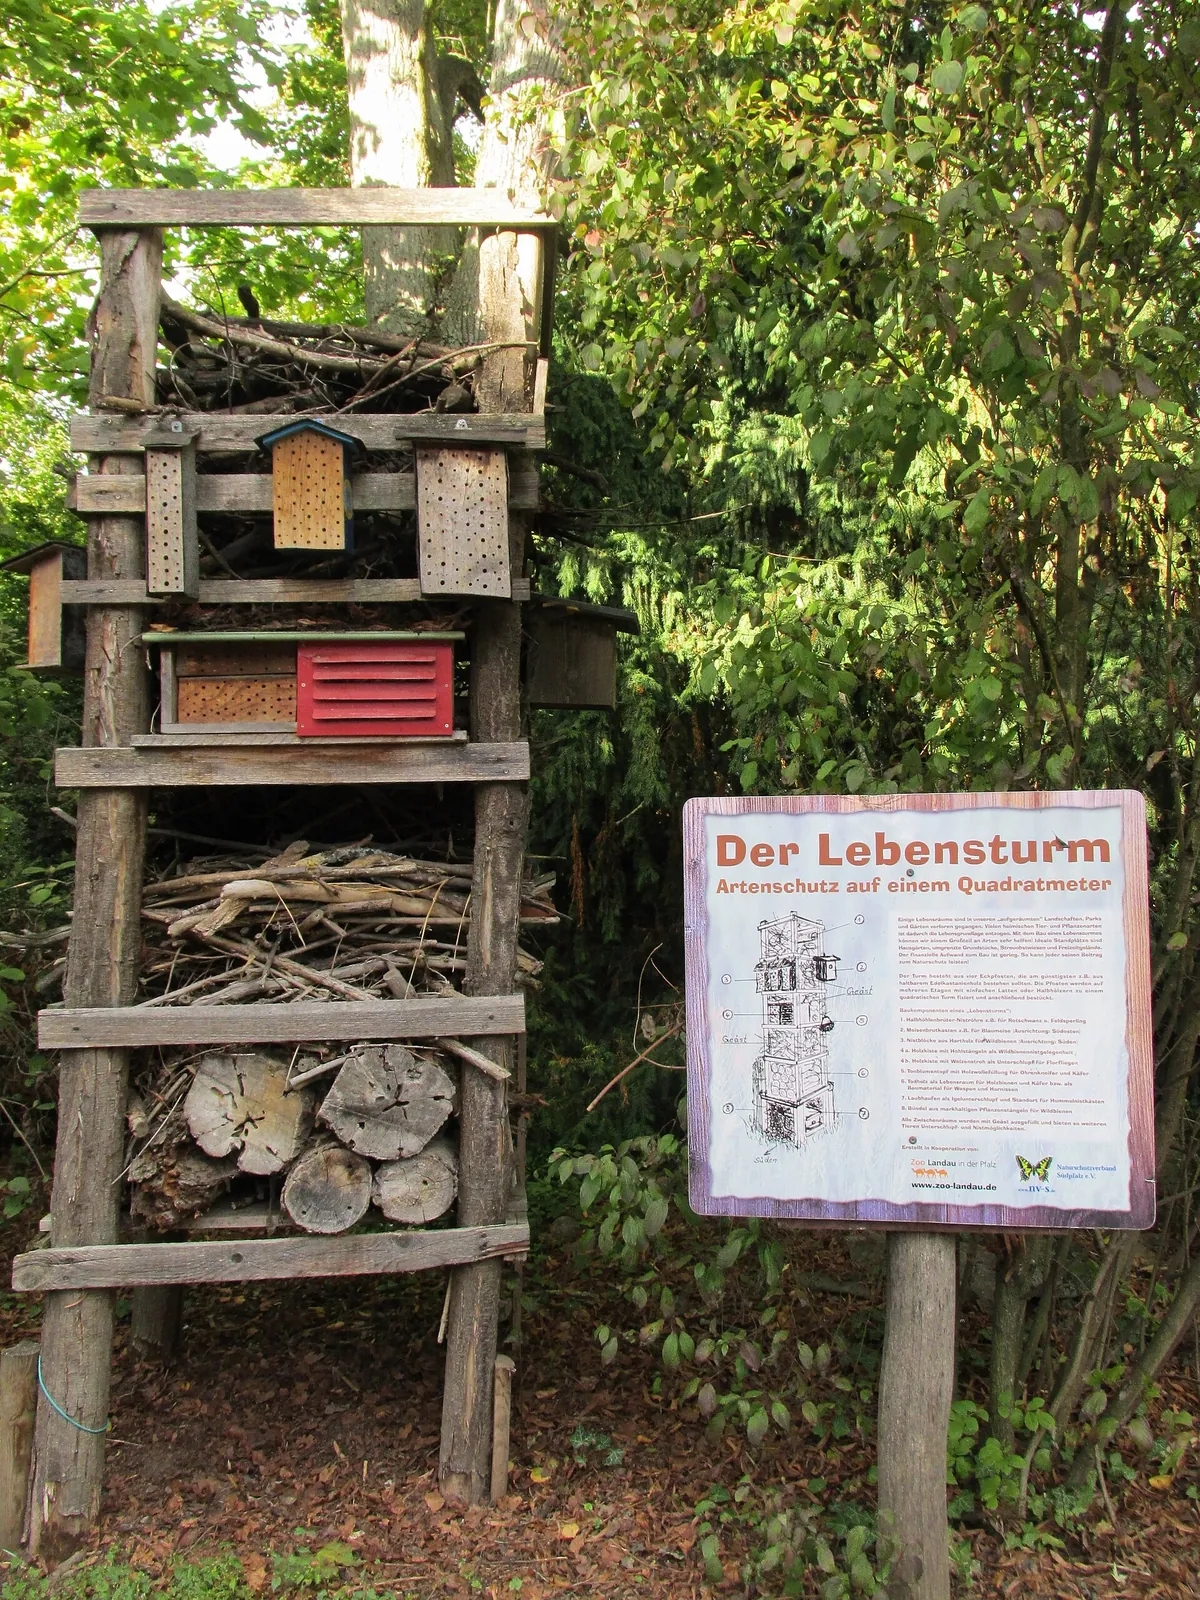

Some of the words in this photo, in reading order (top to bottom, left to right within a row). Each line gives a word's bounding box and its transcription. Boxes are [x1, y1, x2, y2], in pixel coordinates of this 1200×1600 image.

[716, 834, 799, 866] Der
[818, 832, 1111, 866] Lebensturm
[716, 877, 839, 894] Artenschutz
[846, 876, 881, 893] auf
[888, 877, 950, 893] einem
[958, 875, 1112, 895] Quadratmeter
[927, 1159, 956, 1167] Landau
[980, 1160, 996, 1168] Pfalz
[1057, 1164, 1116, 1172] Naturschutzverband
[912, 1182, 997, 1191] www.zoo-landau.de
